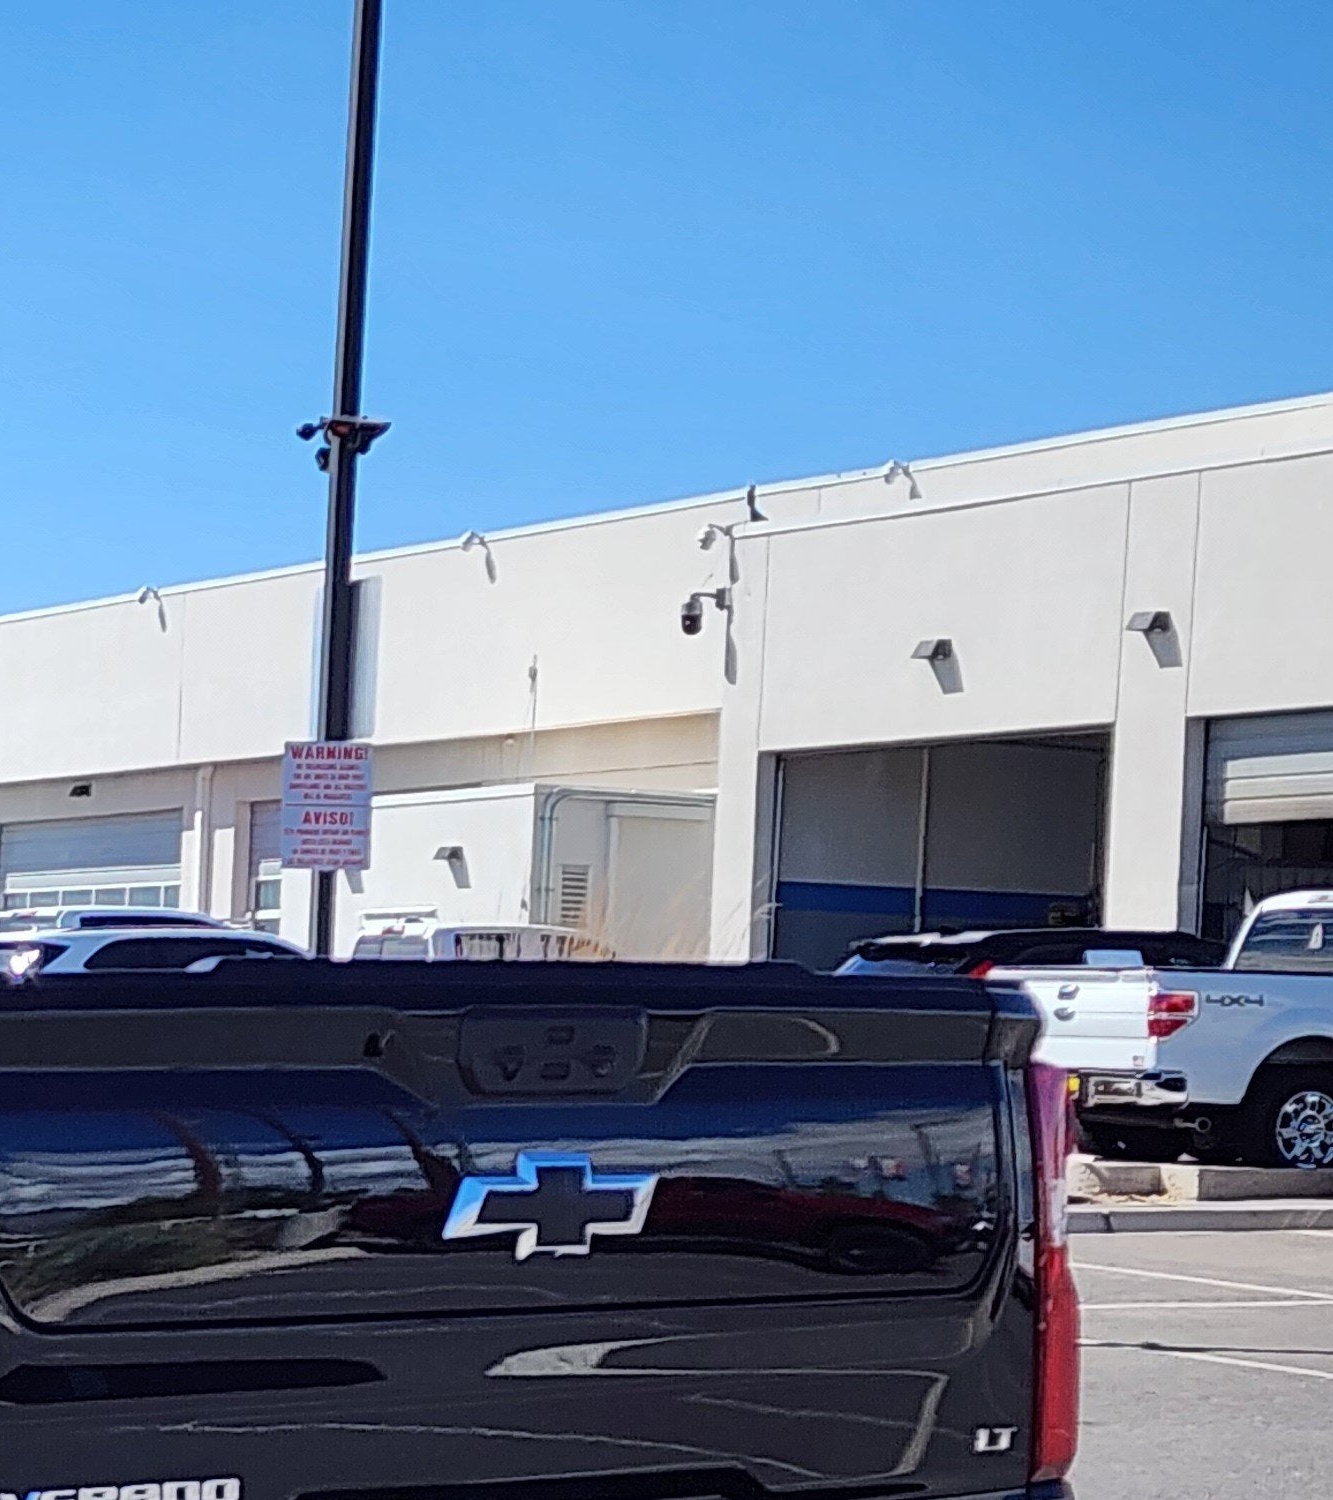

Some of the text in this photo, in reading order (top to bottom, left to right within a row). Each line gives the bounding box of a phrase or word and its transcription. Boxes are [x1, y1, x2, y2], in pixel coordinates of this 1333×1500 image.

[290, 745, 368, 760] WARNING!
[302, 810, 355, 826] AVISO!
[974, 1426, 1018, 1453] LT
